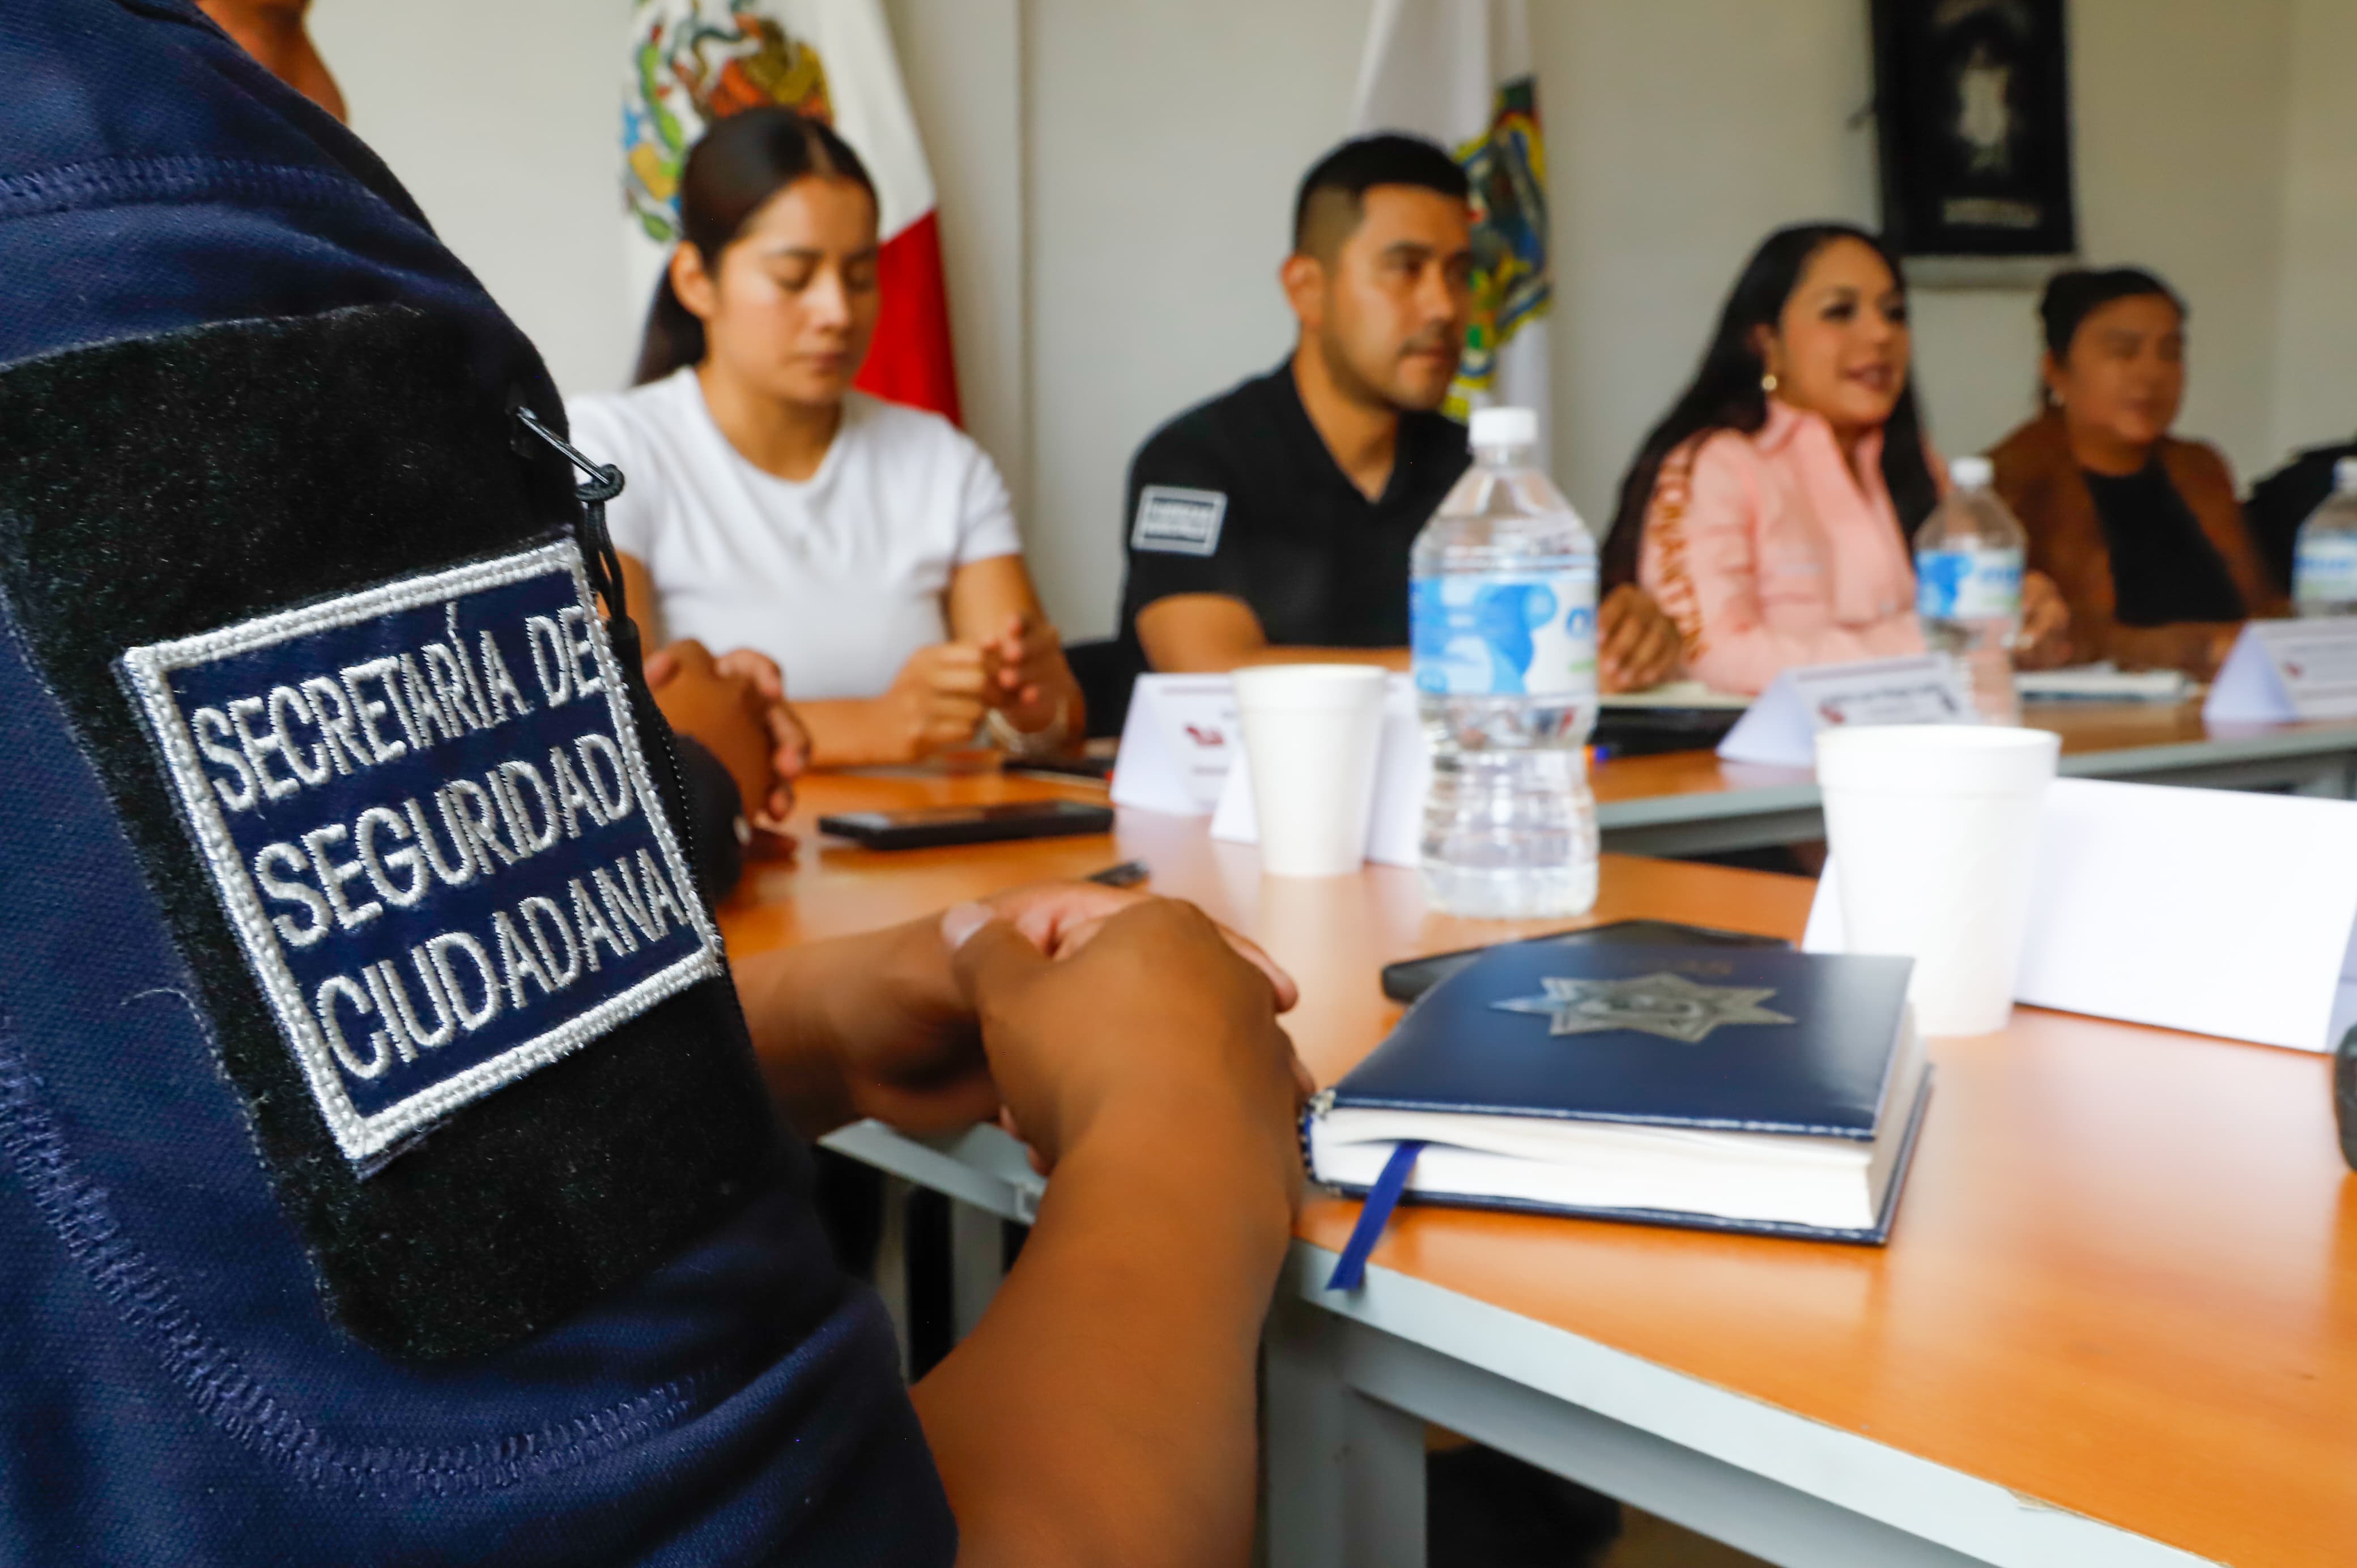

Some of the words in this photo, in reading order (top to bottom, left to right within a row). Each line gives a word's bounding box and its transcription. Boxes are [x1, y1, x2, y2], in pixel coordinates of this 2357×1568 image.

[193, 602, 529, 811] SECRETARÍA
[527, 604, 605, 708] DE
[253, 734, 633, 947] SEGURIDAD
[317, 849, 684, 1079] CIUDADANA
